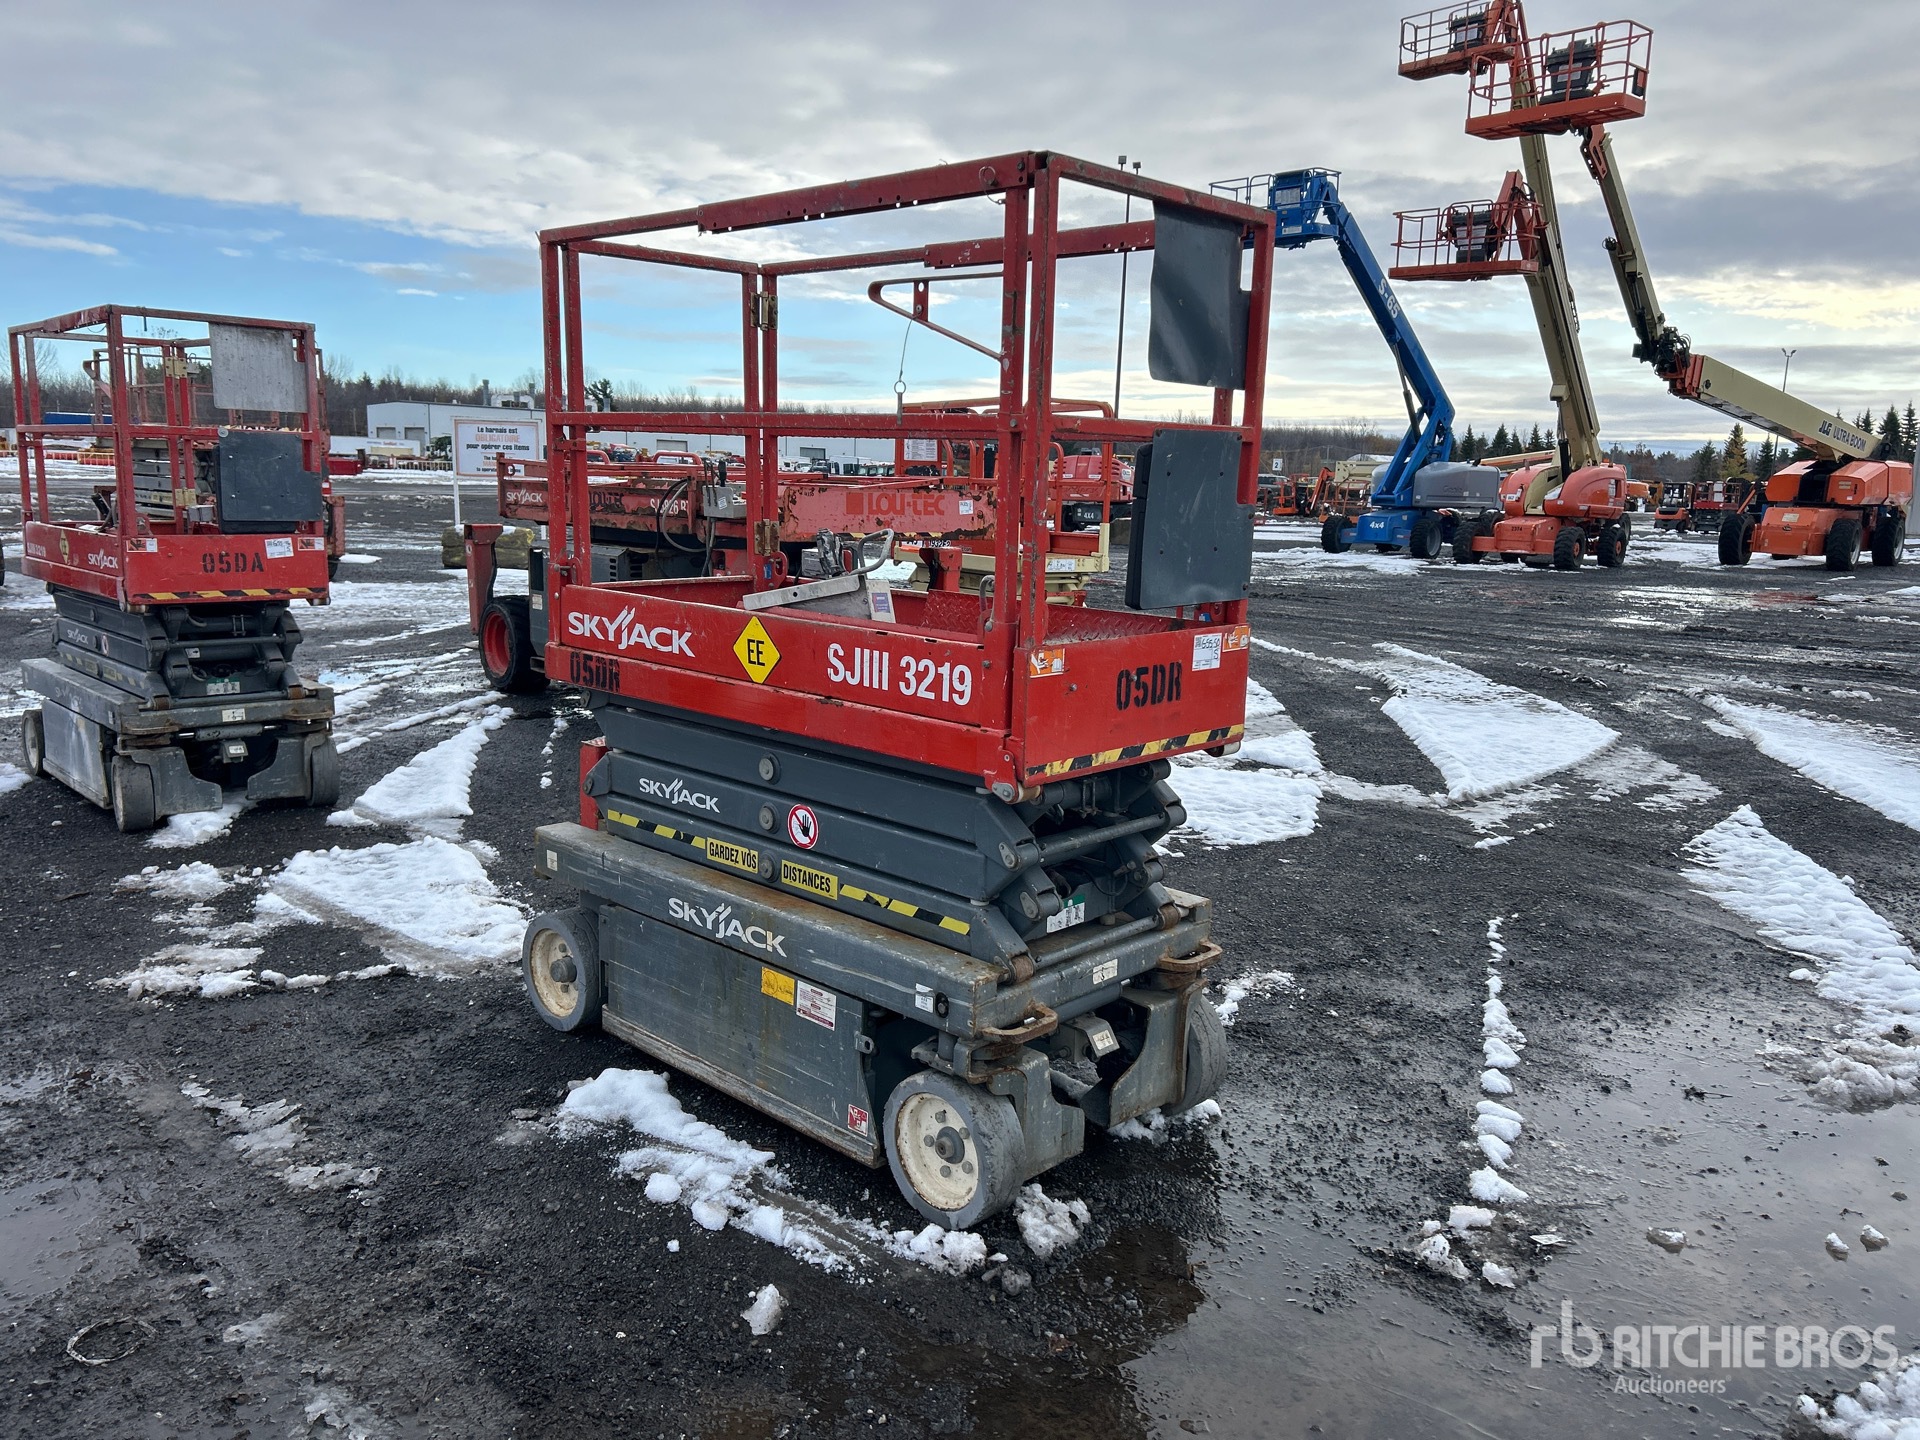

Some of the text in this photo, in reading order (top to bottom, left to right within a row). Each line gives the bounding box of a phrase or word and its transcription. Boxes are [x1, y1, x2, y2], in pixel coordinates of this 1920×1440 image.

[475, 434, 520, 442] OBLIGATOIRE
[506, 489, 543, 504] SKYJACK
[1369, 521, 1385, 529] 4x4
[88, 549, 118, 569] SKYJACK
[202, 552, 264, 573] 05DA
[568, 605, 696, 658] SKYJACK
[747, 638, 766, 667] EE
[827, 643, 972, 706] SJIII 3219
[1116, 661, 1183, 711] 05DR
[639, 778, 720, 813] SKYJACK
[709, 841, 831, 893] GARDEZ VOS DISTANCES
[668, 897, 787, 958] SKYJACK
